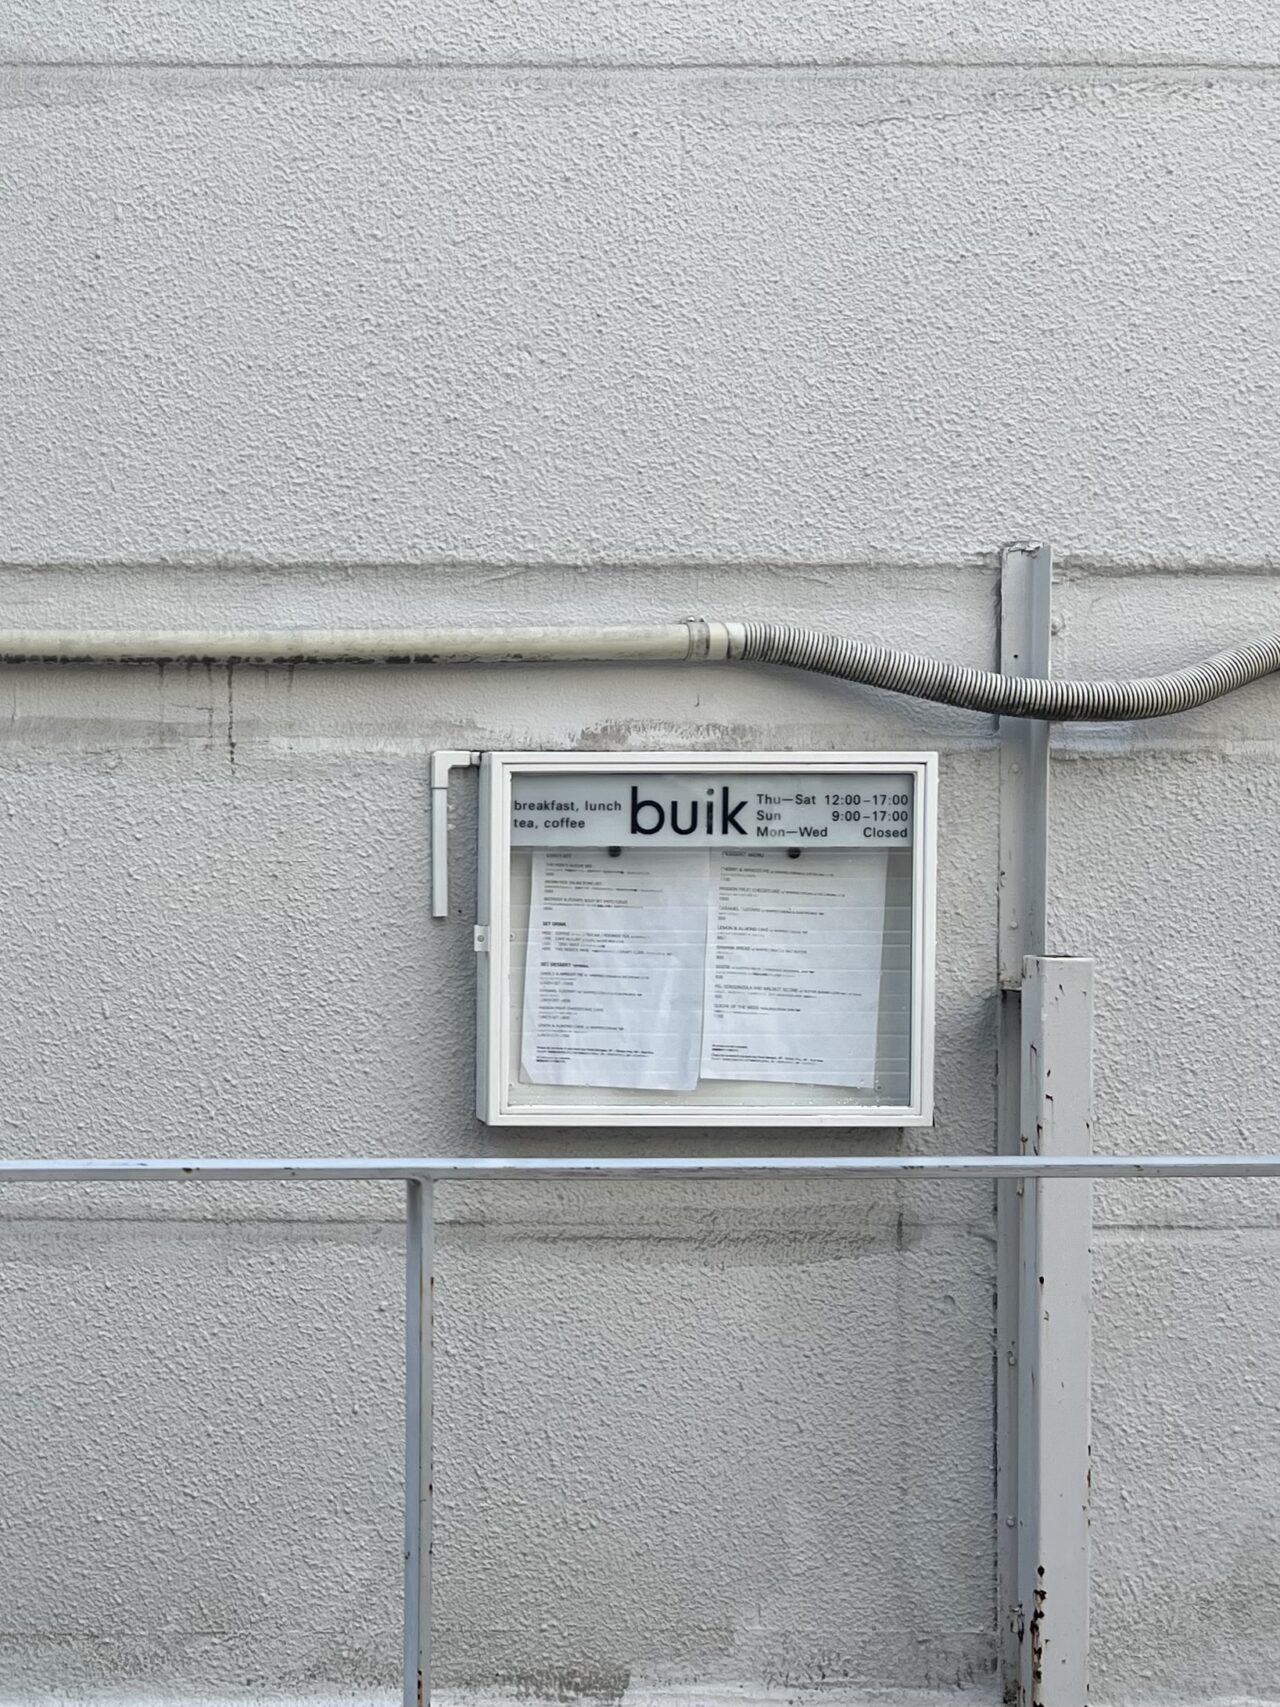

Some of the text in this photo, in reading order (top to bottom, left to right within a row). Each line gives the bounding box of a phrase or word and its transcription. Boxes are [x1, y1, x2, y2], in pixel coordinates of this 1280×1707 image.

[514, 800, 622, 812] breakfast, lunch
[631, 786, 748, 835] buik
[756, 809, 782, 821] Sun
[513, 818, 586, 829] tea, coffee
[863, 826, 908, 838] Closed
